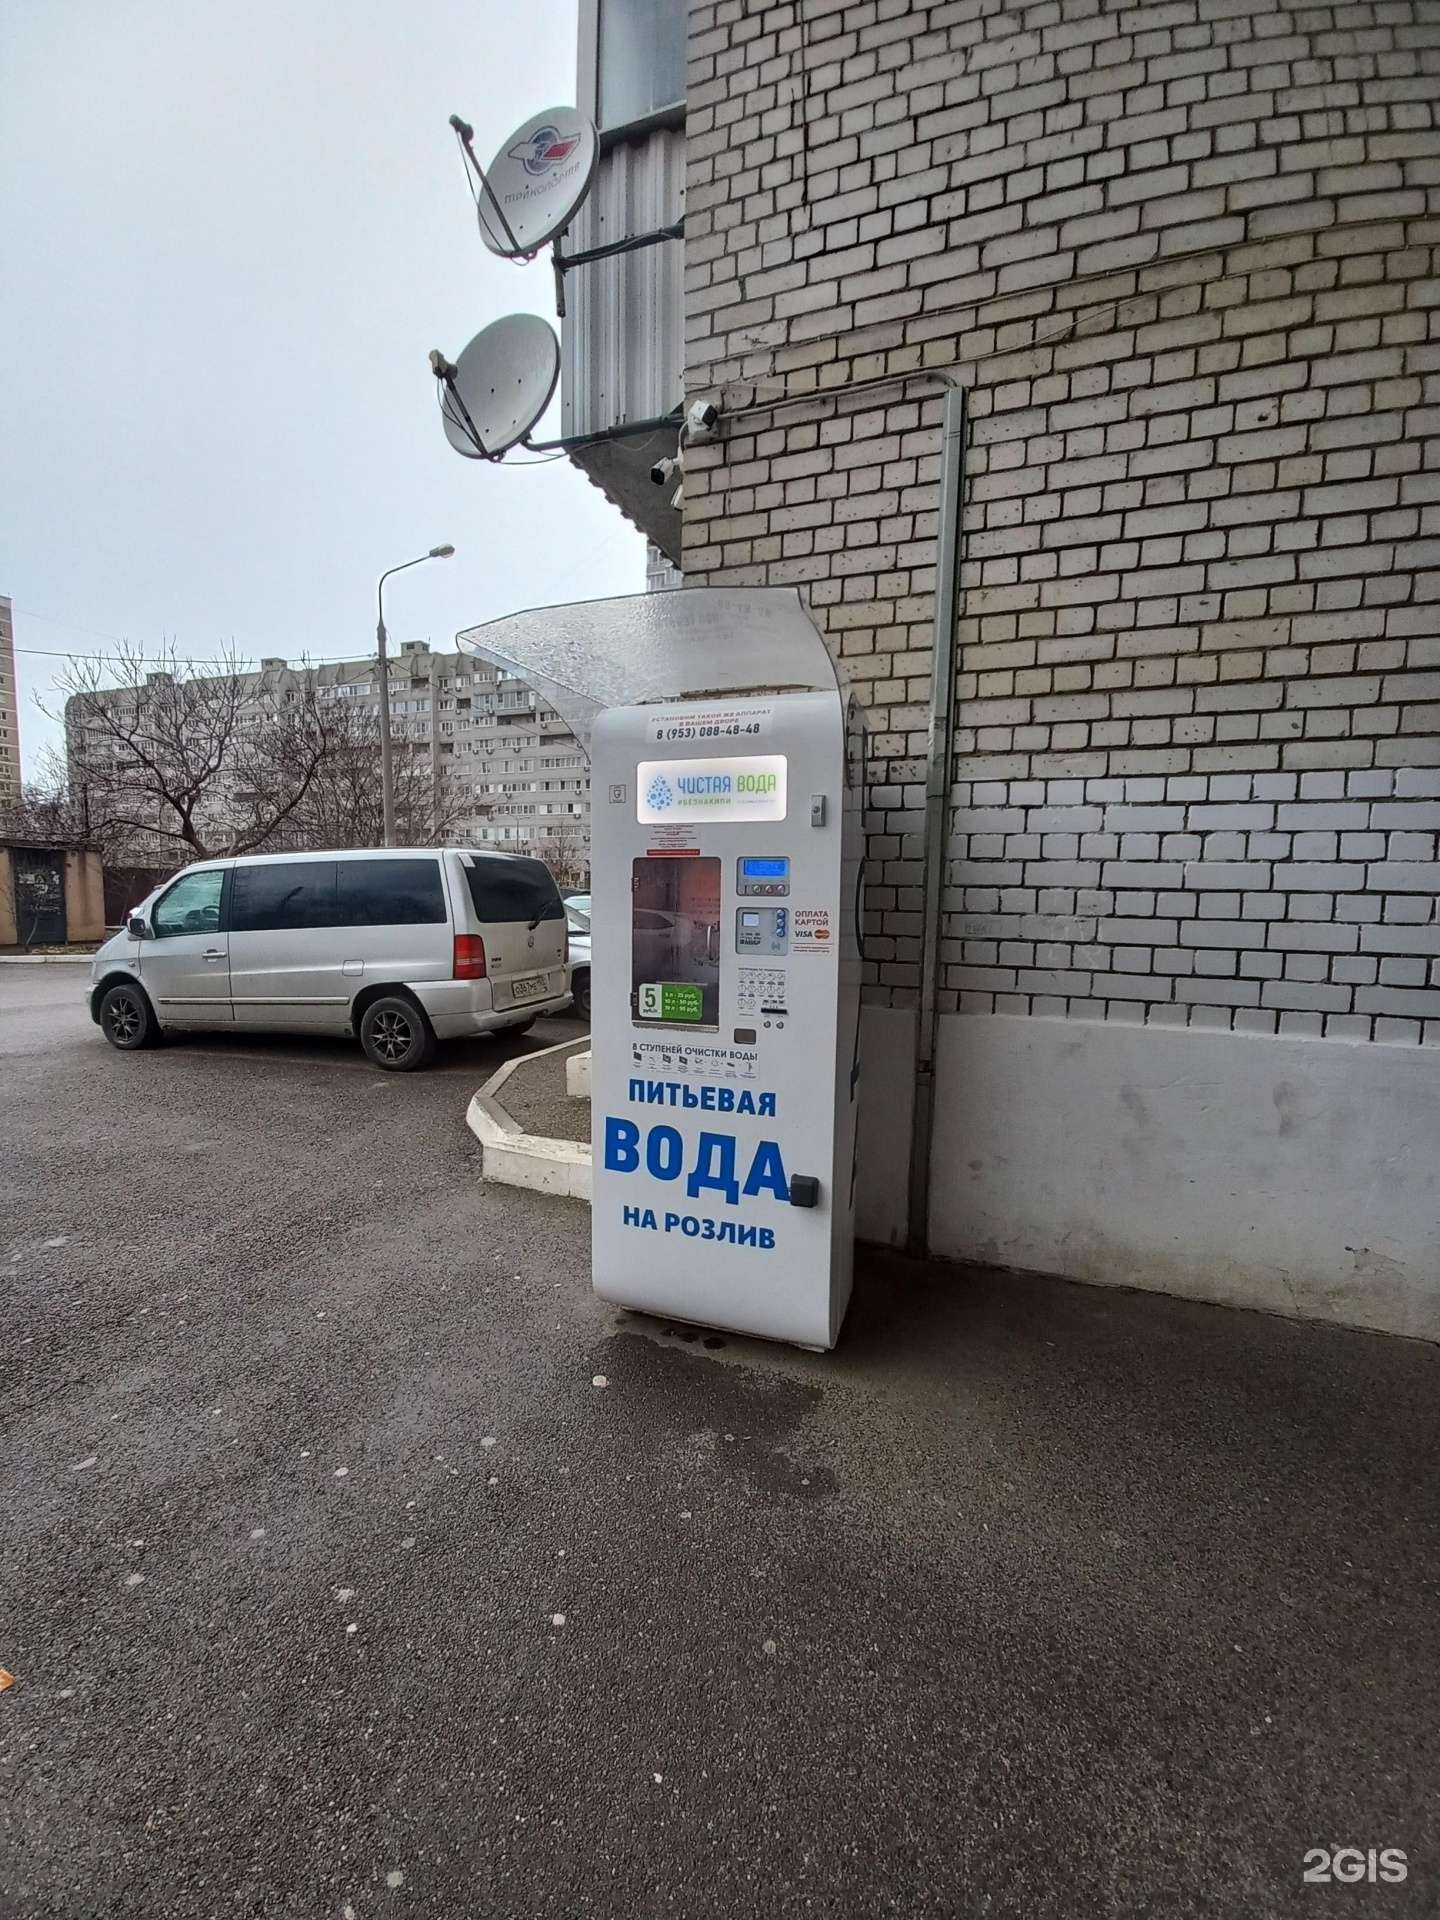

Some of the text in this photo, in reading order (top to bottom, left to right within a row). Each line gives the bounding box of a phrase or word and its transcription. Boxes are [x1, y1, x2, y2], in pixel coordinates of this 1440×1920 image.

[736, 709, 772, 717] АППАРАТ
[656, 723, 760, 740] 8 (953) 088-48-48
[678, 774, 776, 794] ЧИСТАЯ ВОДА
[794, 918, 829, 926] КАРТОЙ
[645, 988, 656, 1008] 5
[640, 1043, 682, 1054] СТУПЕНЕЙ
[684, 1047, 726, 1058] ОЧИСТКИ
[730, 1051, 758, 1061] ВОДЫ
[628, 1078, 776, 1117] ПИТЬЕВАЯ
[604, 1116, 792, 1206] ВОДА
[623, 1205, 776, 1250] НА РОЗЛИВ
